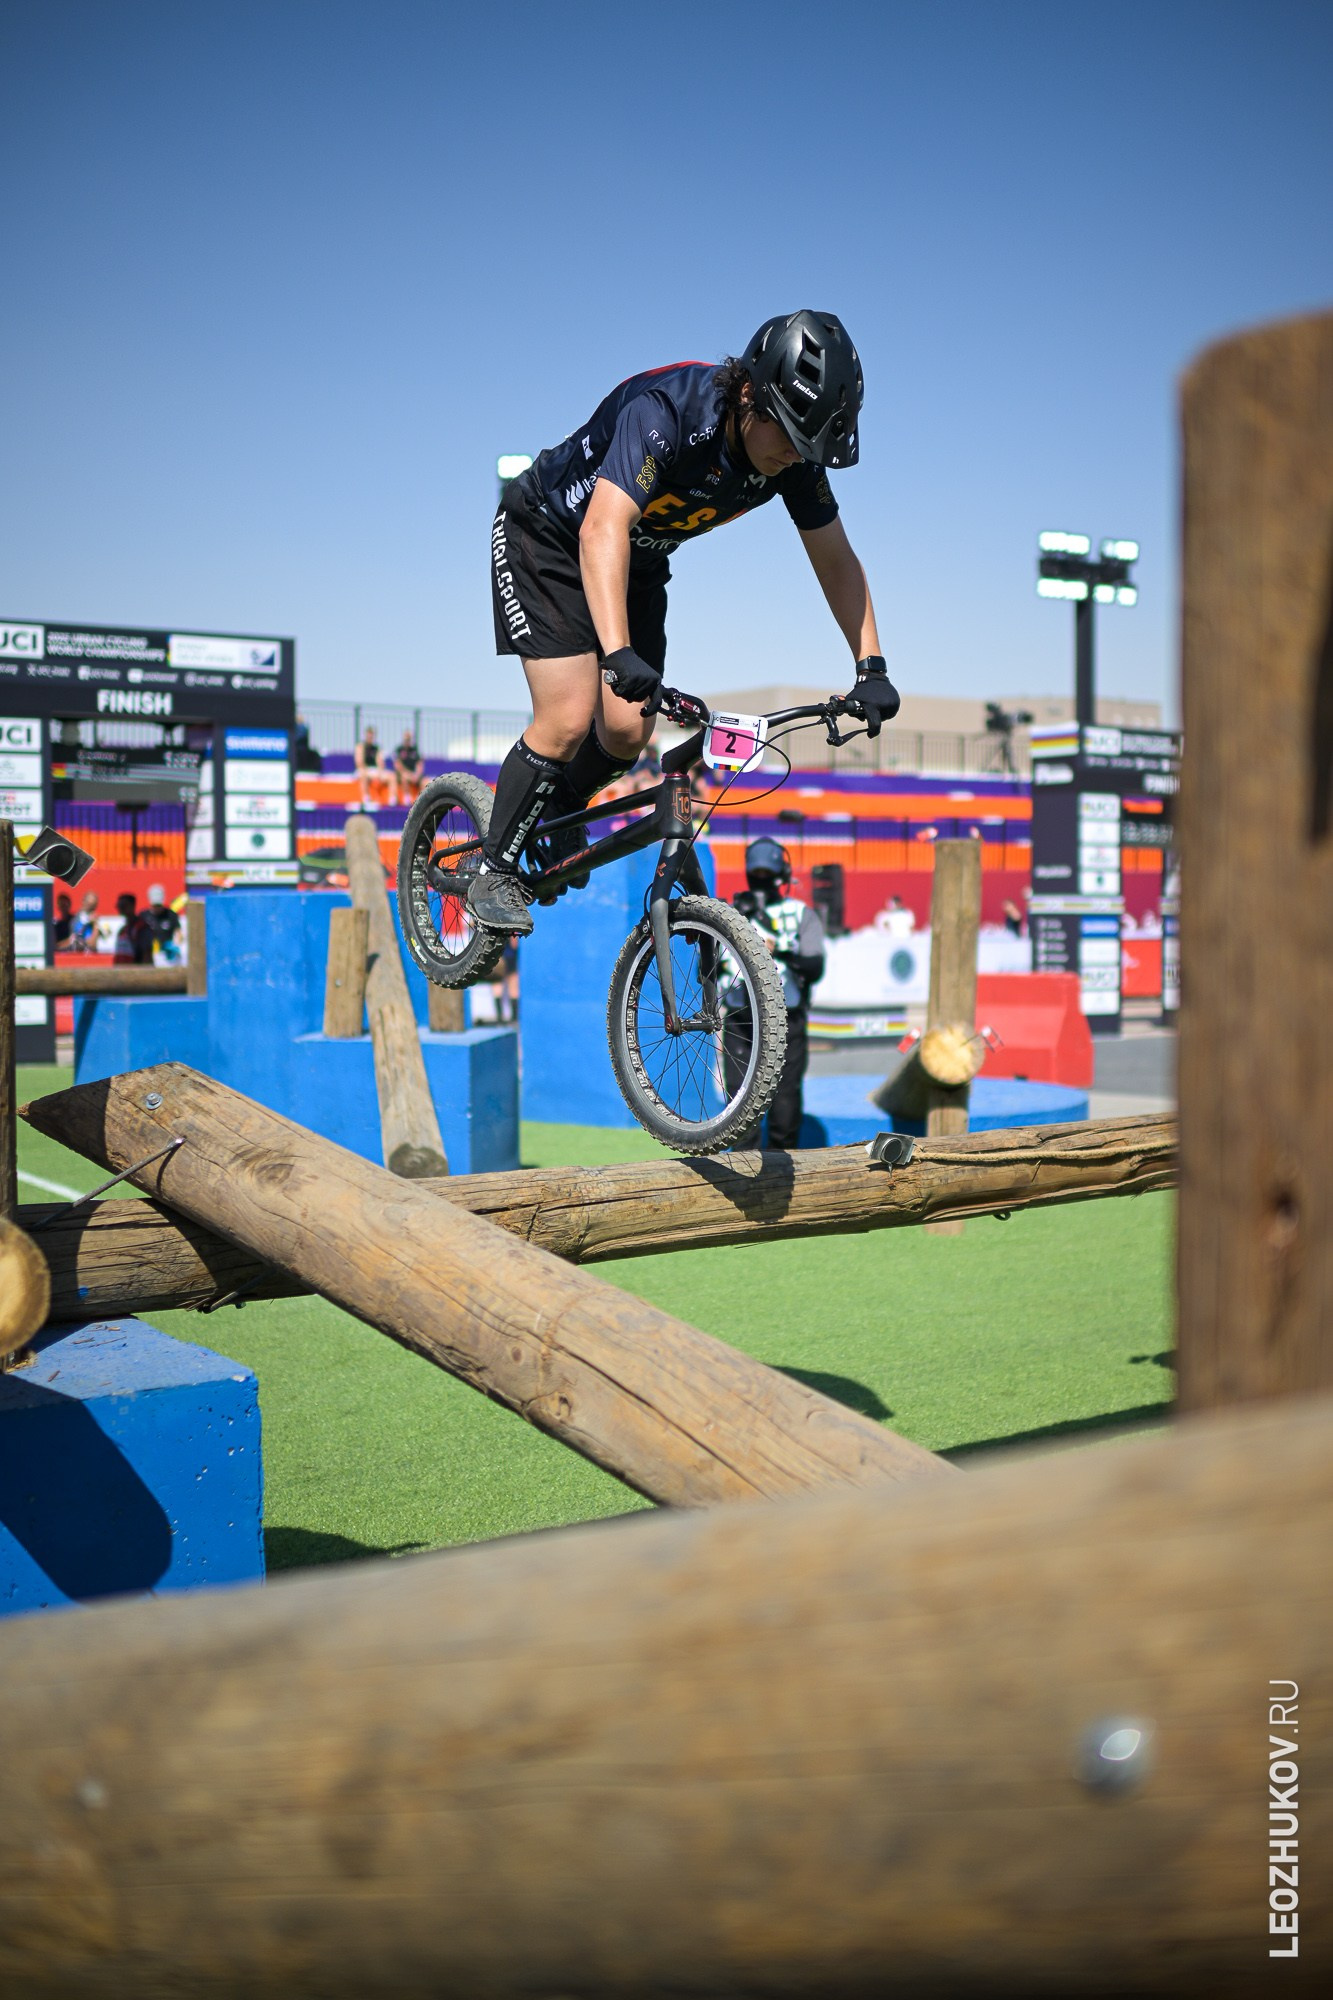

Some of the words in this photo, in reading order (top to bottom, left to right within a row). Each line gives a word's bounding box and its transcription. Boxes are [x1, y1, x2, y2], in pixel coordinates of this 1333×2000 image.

[793, 379, 818, 400] hebo
[97, 688, 173, 715] FINISH
[724, 731, 737, 754] 2
[502, 799, 545, 863] hebo
